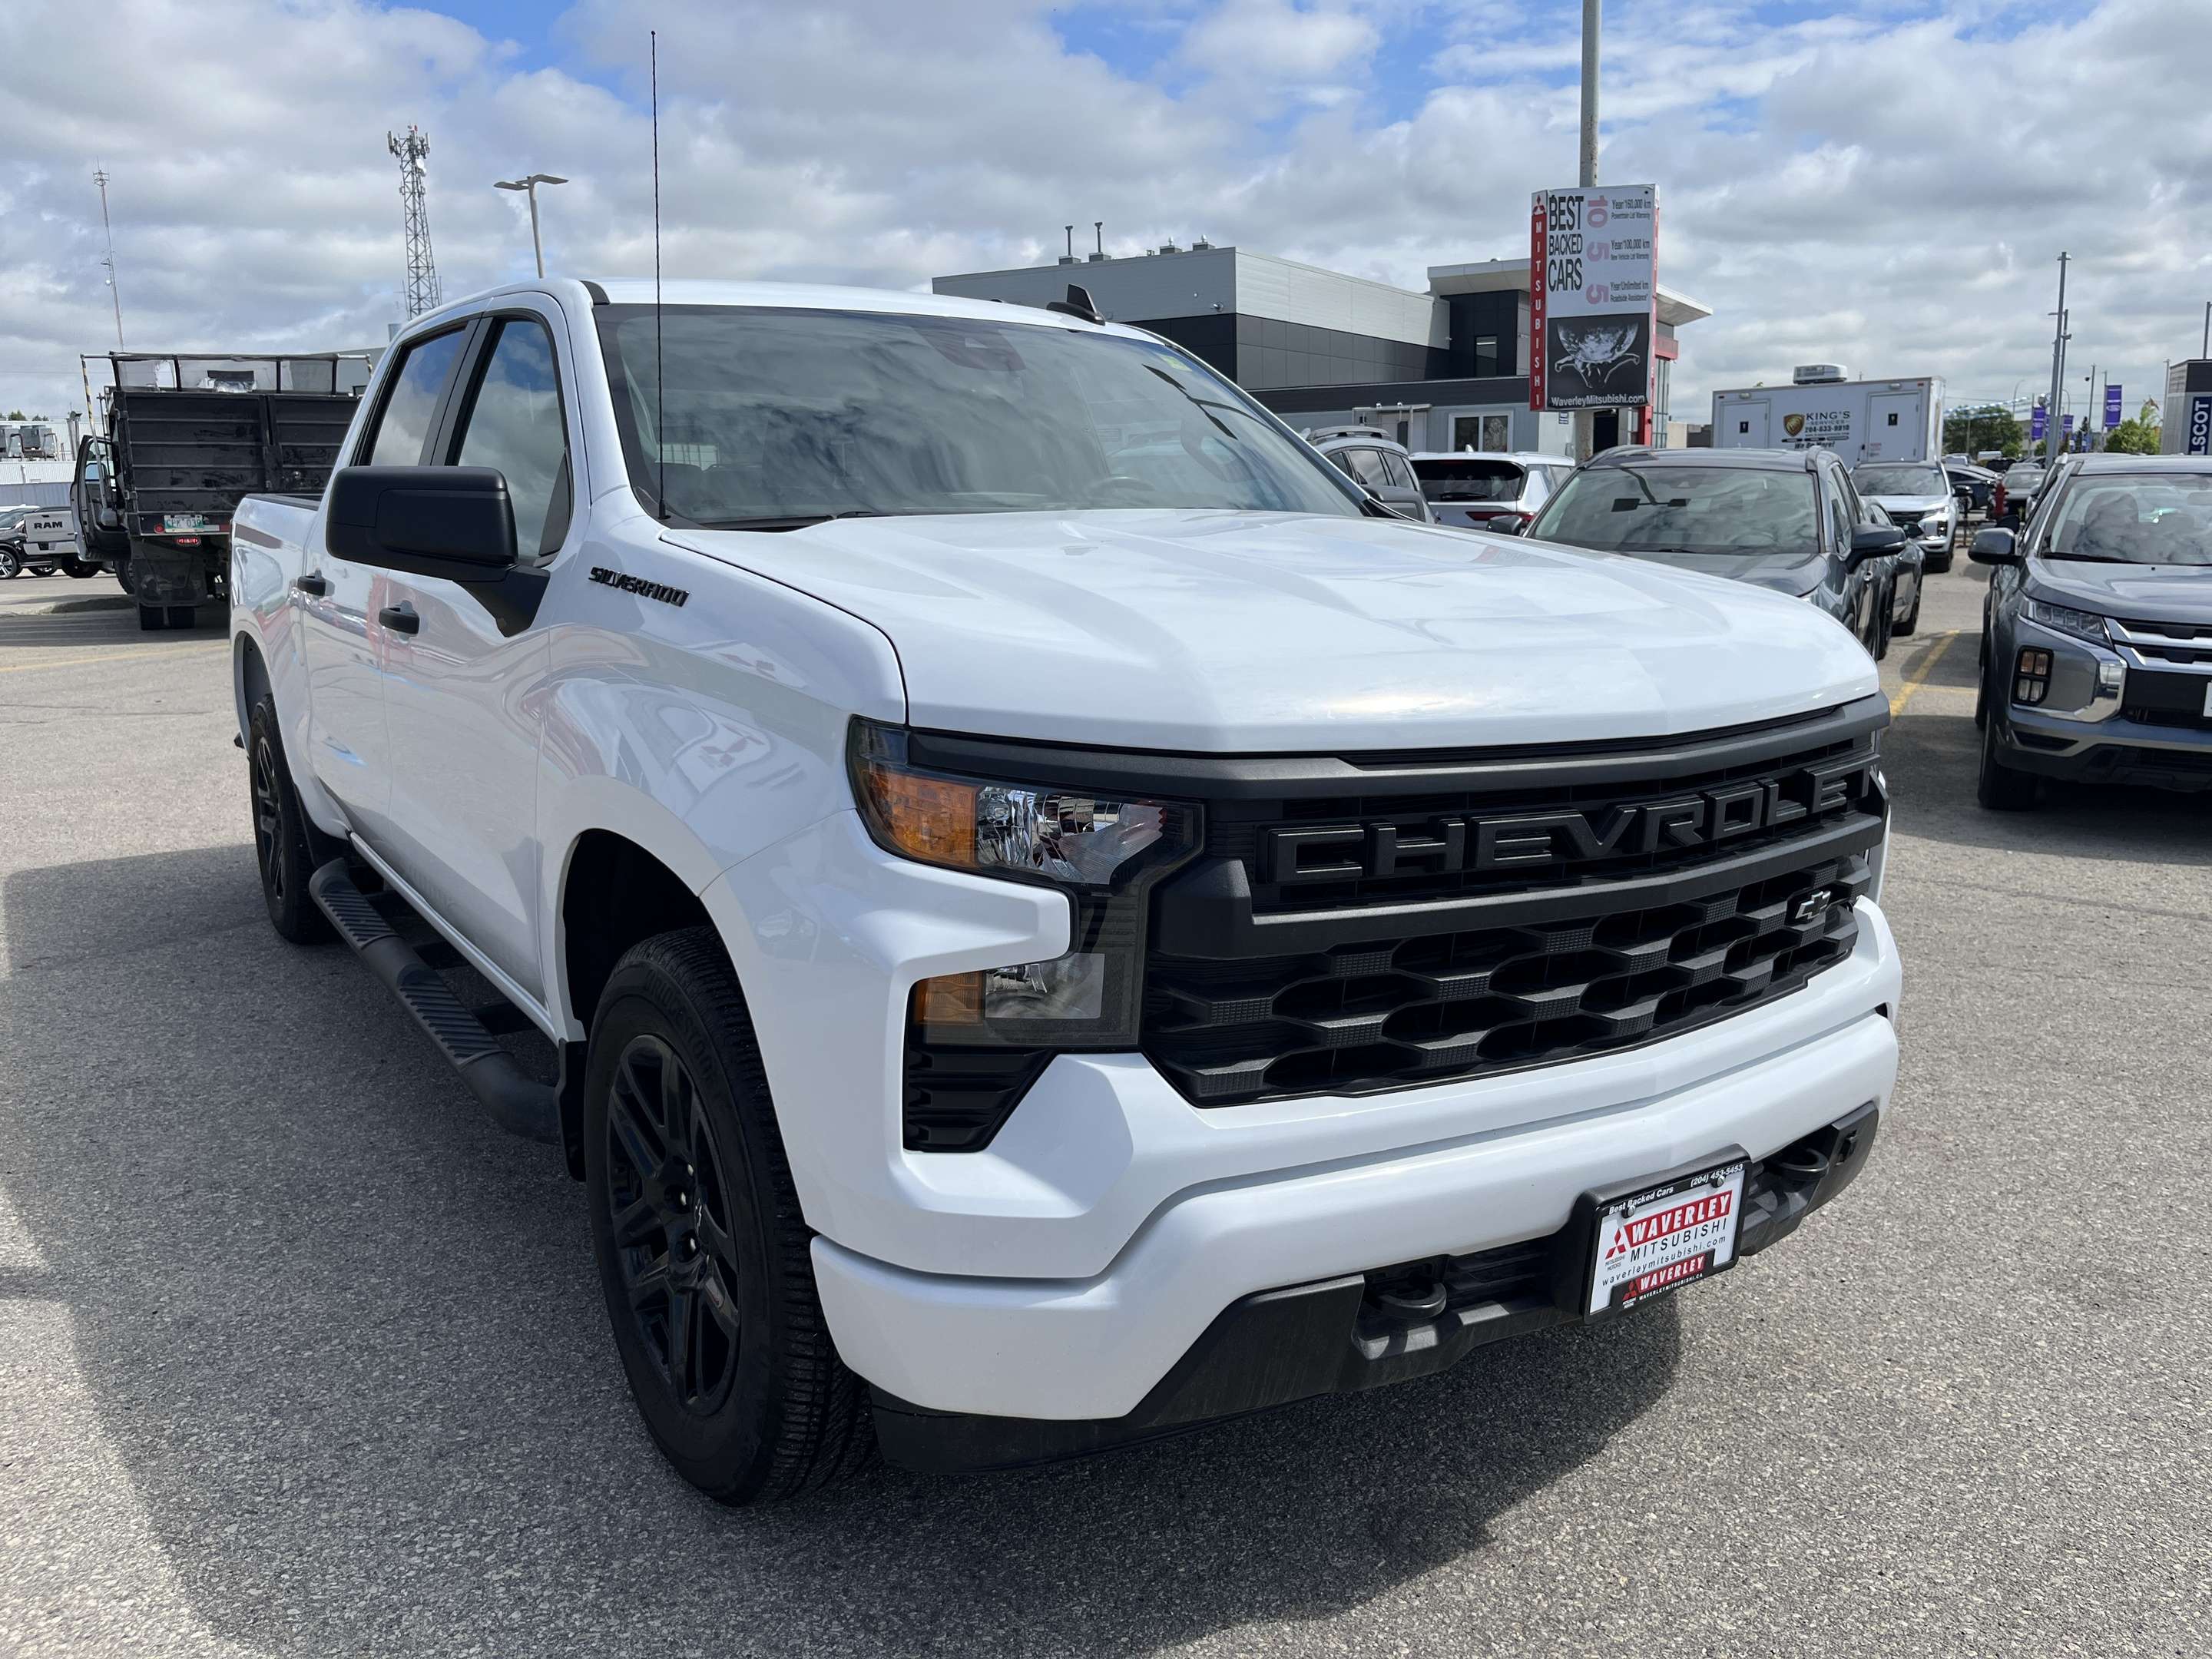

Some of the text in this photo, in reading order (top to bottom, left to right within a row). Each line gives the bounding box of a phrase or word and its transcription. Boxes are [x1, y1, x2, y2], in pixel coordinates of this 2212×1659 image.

[1548, 195, 1584, 231] BEST
[1587, 195, 1608, 228] 10
[1548, 233, 1583, 257] BACKED
[1586, 241, 1609, 262] 5
[1548, 257, 1583, 292] CARS
[1585, 283, 1609, 305] 5
[1551, 394, 1645, 408] WaverleyMitsubishi.com
[1806, 411, 1850, 420] KING'S
[34, 521, 63, 529] RAM
[588, 566, 690, 607] SILVERADO
[1608, 1202, 1626, 1215] Best
[1627, 1191, 1655, 1208] Backed
[1656, 1187, 1674, 1197] Cars
[1690, 1174, 1710, 1187] (204)
[1631, 1194, 1730, 1245] WAVERLEY
[1630, 1217, 1727, 1263] MITSUBISHI
[1602, 1235, 1727, 1286] waverleymitsubishi.com
[1640, 1255, 1704, 1291] WAVERLEY
[1639, 1273, 1703, 1301] WAVERLEYMITSUBISHI.CA
